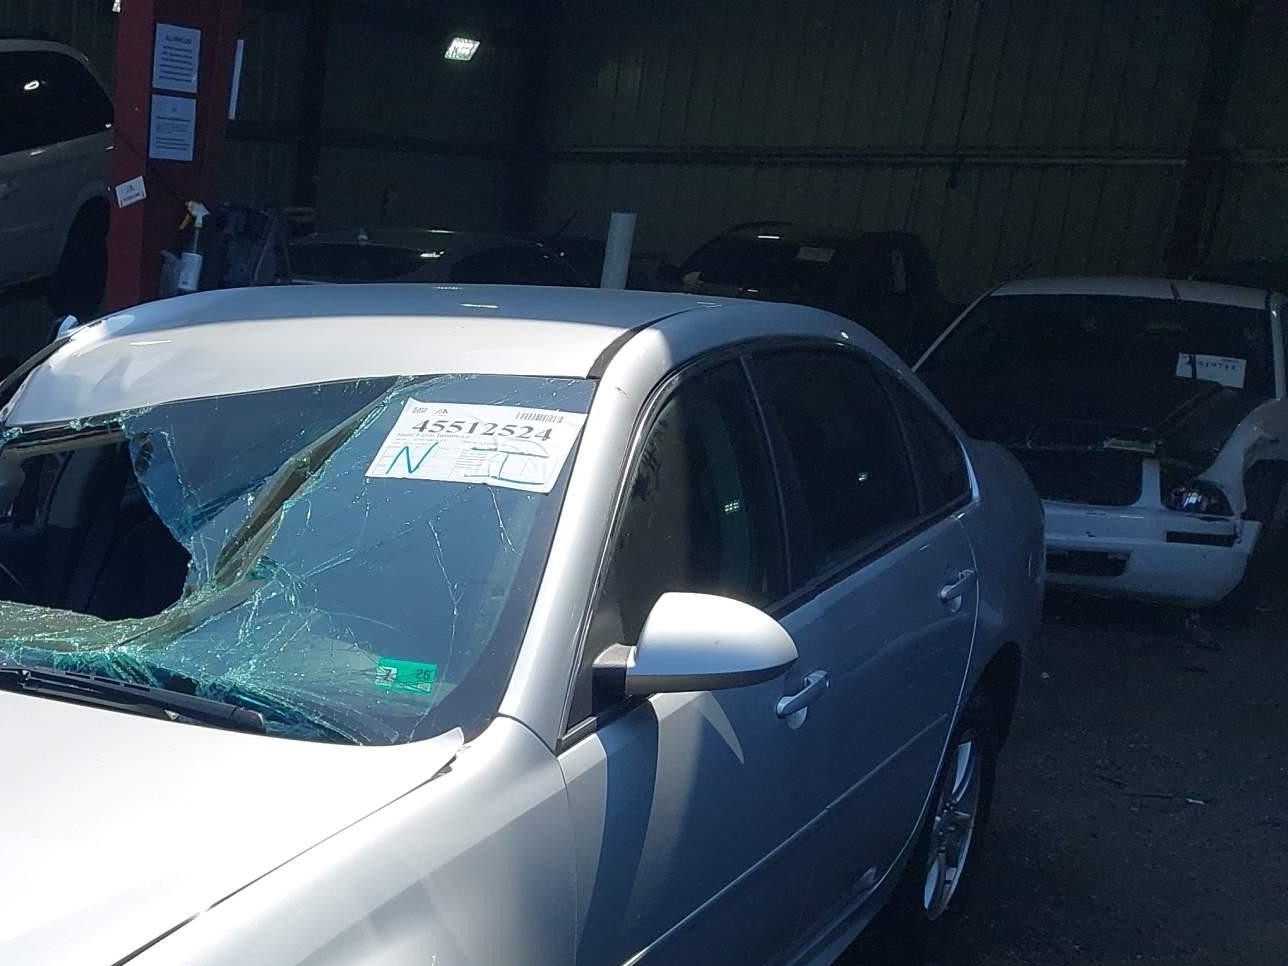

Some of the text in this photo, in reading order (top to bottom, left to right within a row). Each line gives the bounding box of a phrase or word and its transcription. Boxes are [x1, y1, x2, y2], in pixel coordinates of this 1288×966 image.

[412, 418, 553, 441] 45512524
[385, 442, 439, 474] N
[416, 668, 431, 681] 26
